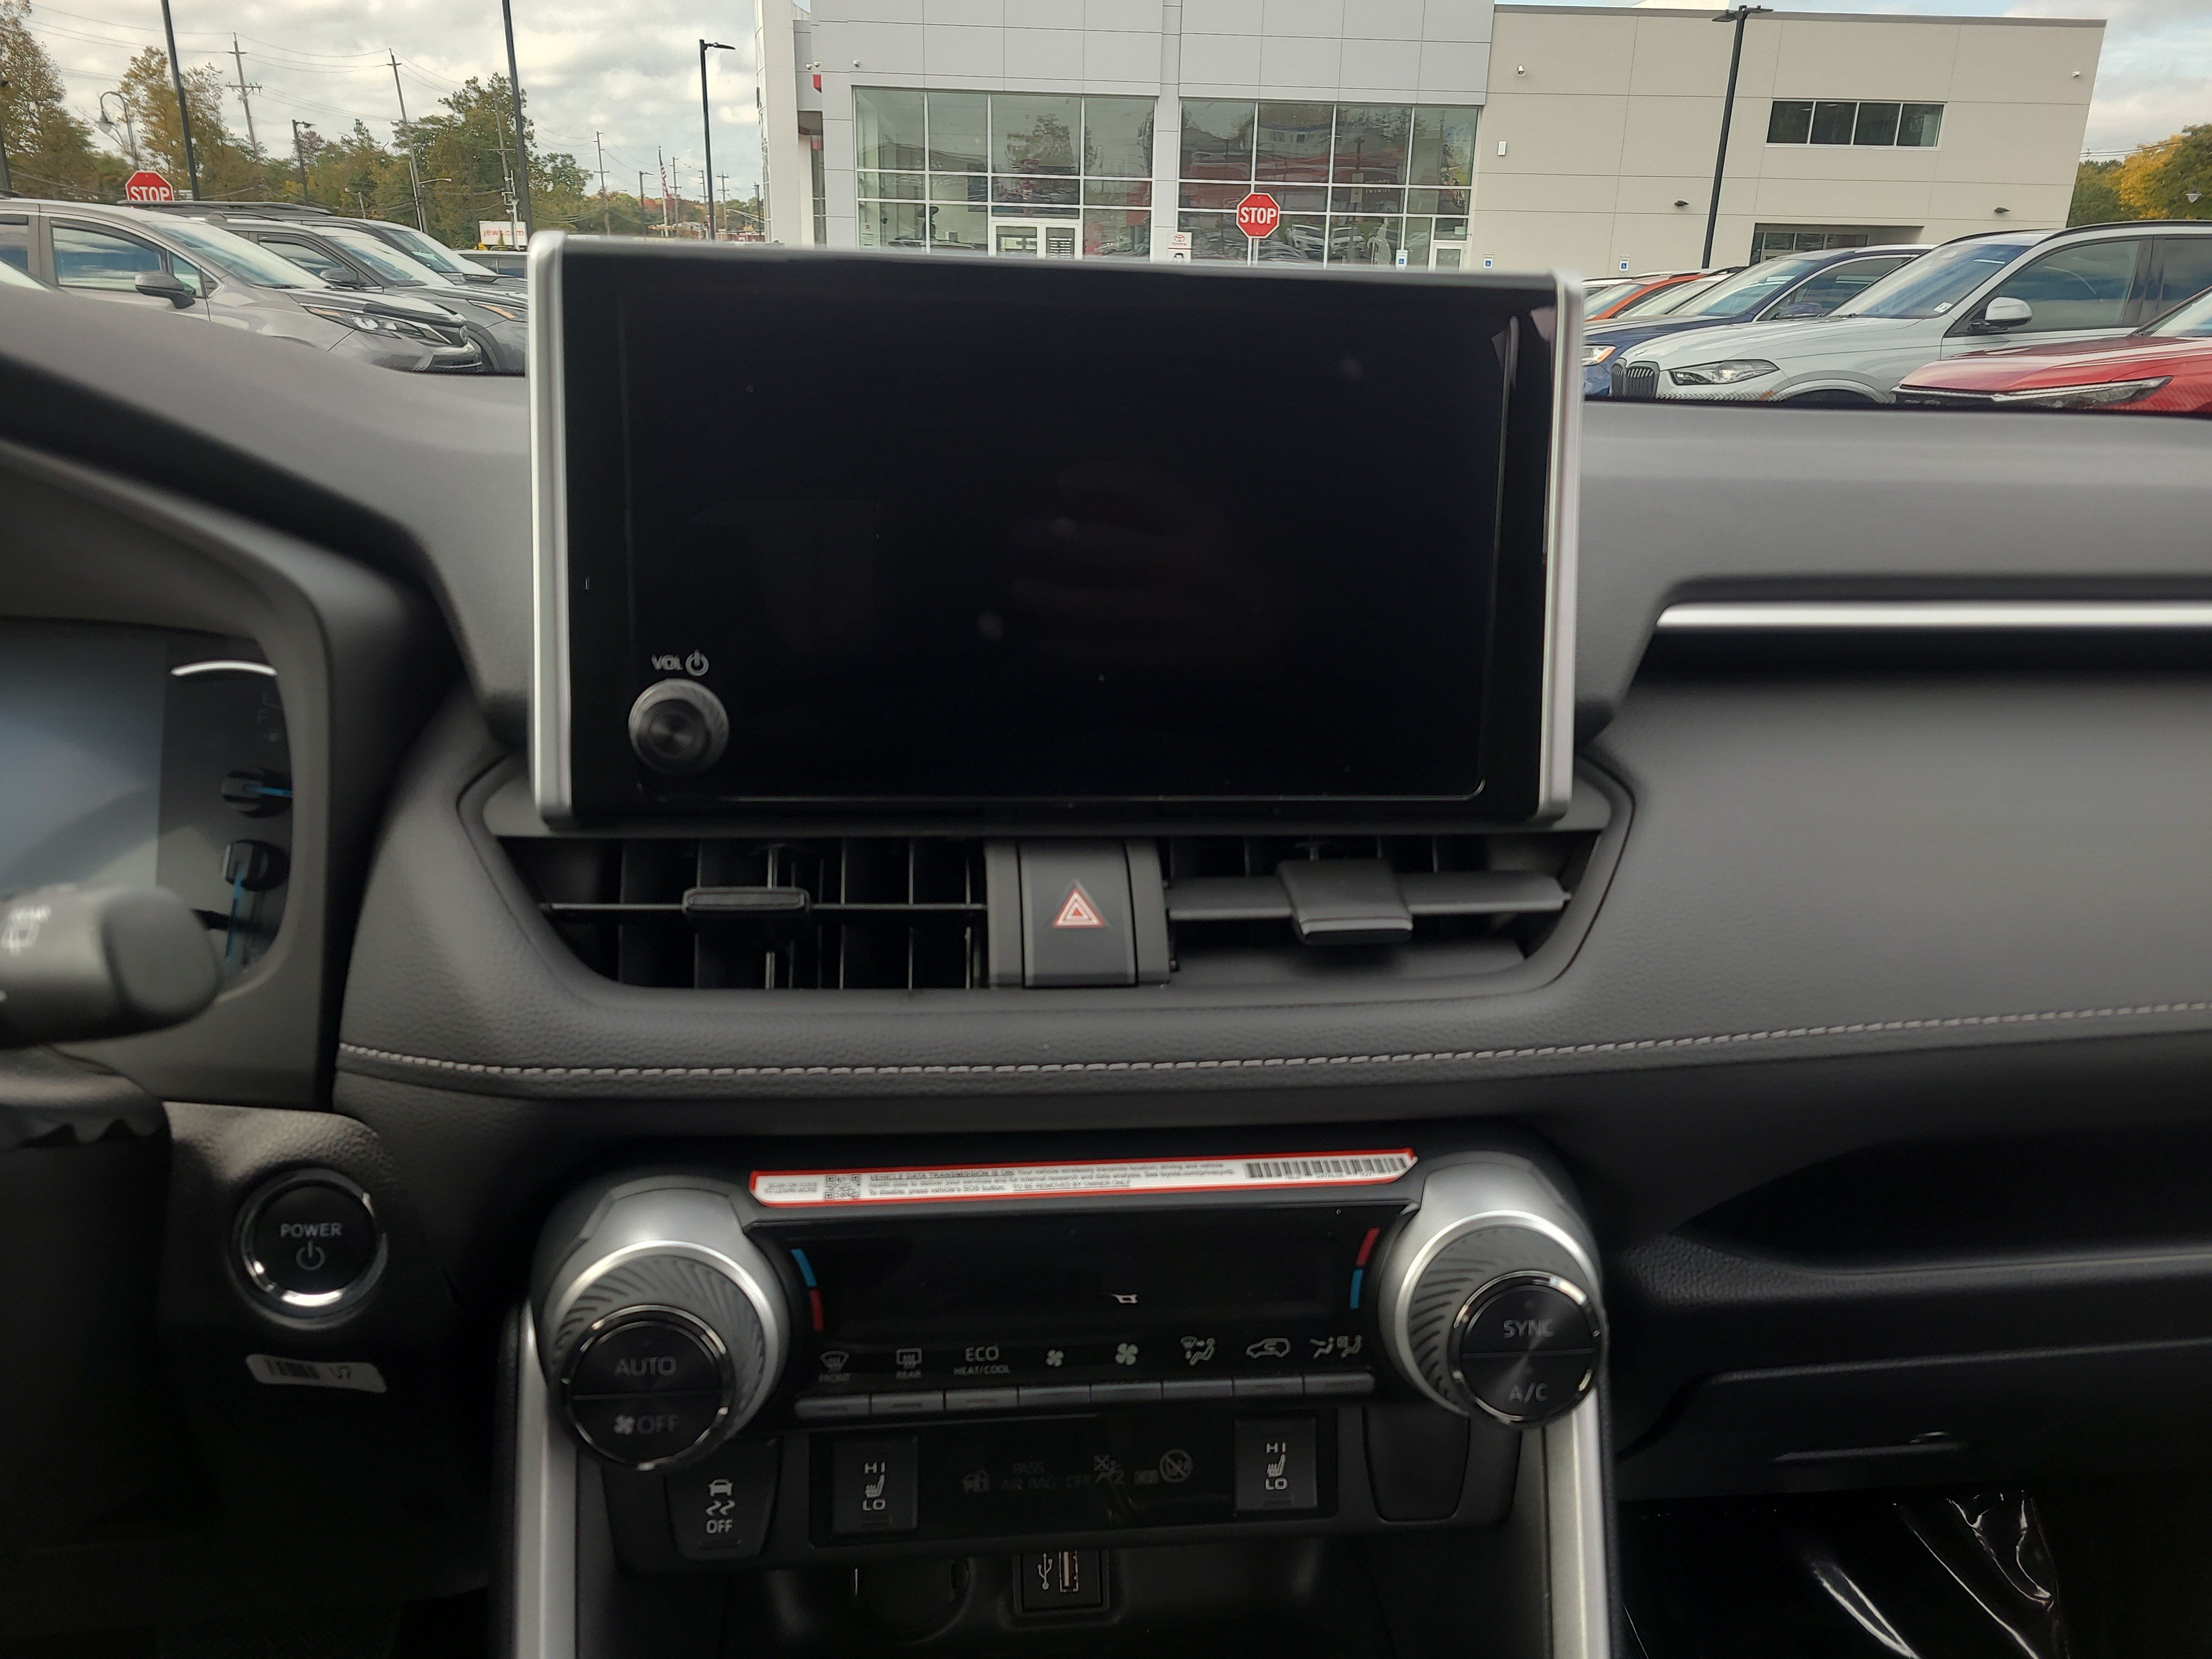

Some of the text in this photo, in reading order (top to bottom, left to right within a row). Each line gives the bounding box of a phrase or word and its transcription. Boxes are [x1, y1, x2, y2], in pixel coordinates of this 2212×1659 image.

[130, 185, 170, 201] STOP
[1239, 206, 1277, 224] STOP
[651, 654, 684, 670] VOL
[280, 1222, 342, 1238] POWER
[1503, 1319, 1554, 1338] SYNC
[965, 1346, 1000, 1363] ECO
[613, 1356, 677, 1376] AUTO
[953, 1364, 1010, 1376] HEAT/COOL
[1509, 1383, 1549, 1403] A/C
[637, 1414, 679, 1434] OFF
[1266, 1441, 1287, 1454] HI
[864, 1461, 885, 1474] HI
[1265, 1477, 1288, 1491] LO
[862, 1498, 887, 1511] LO
[706, 1519, 733, 1534] OFF
